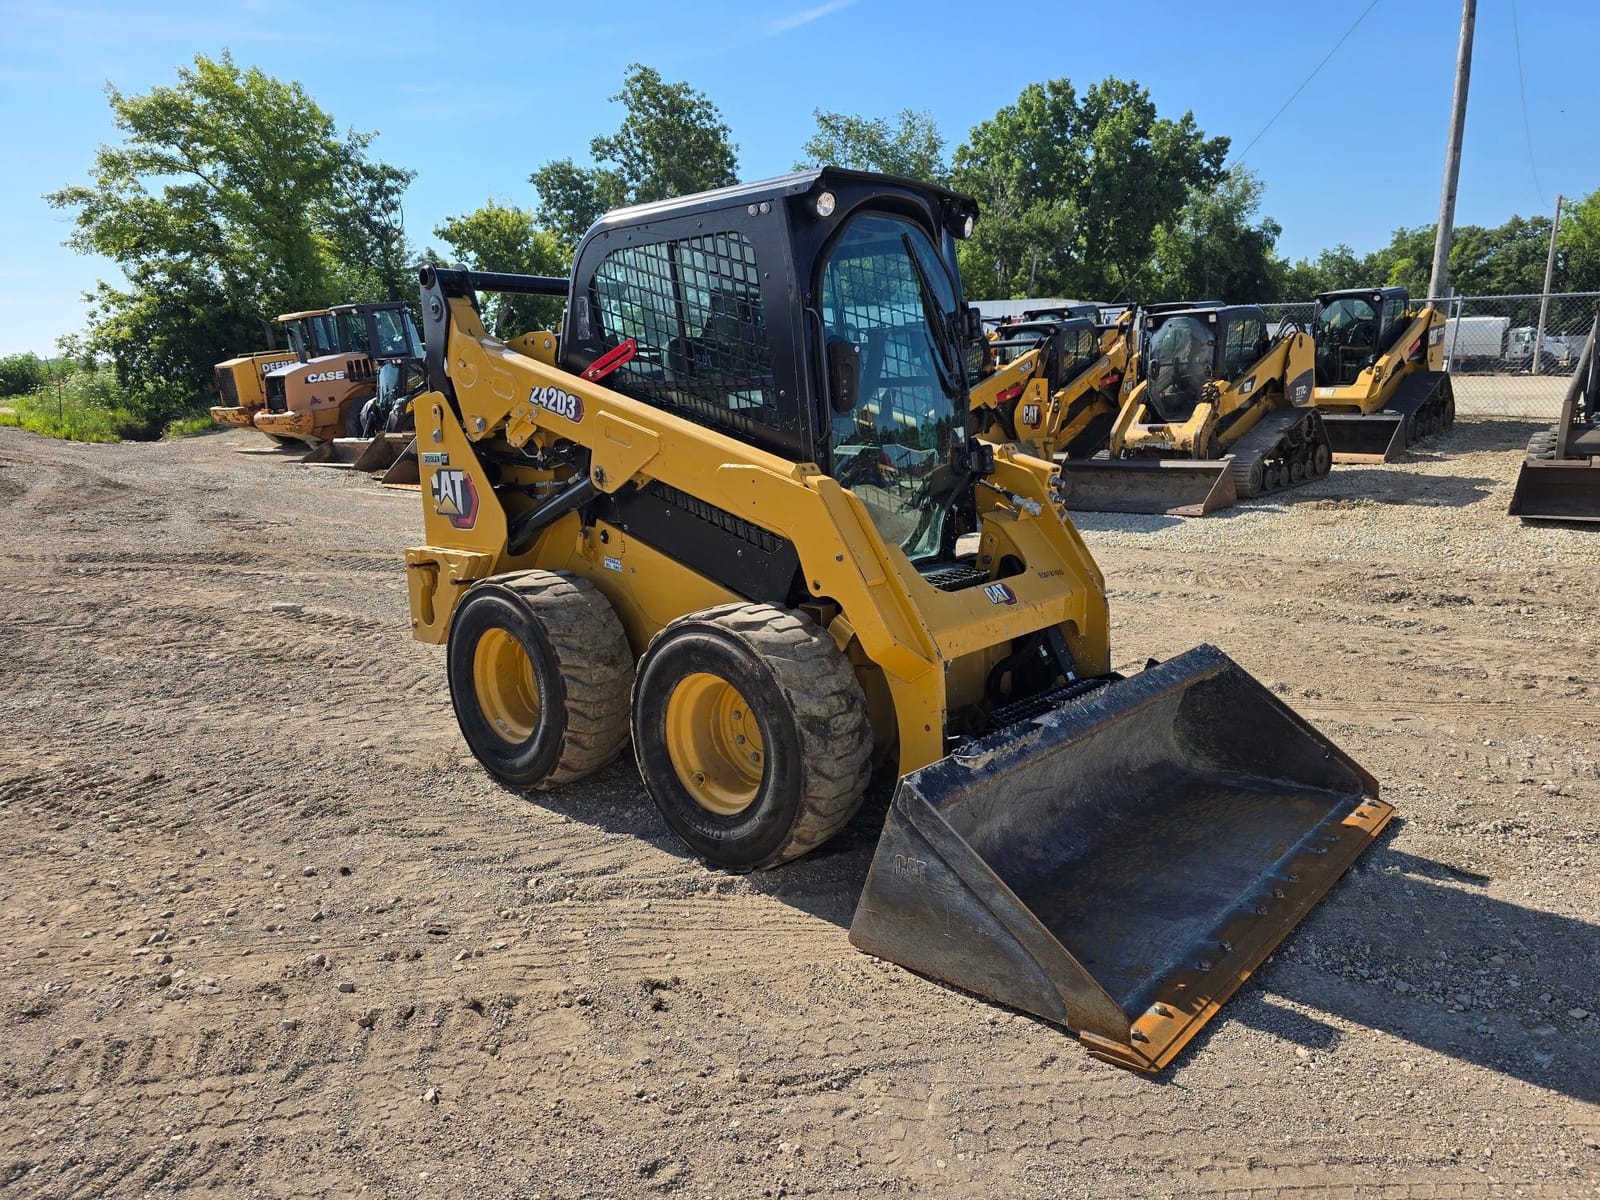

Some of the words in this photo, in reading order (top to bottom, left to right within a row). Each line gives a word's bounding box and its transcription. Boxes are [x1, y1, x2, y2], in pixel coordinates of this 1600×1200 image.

[261, 360, 294, 373] DEER
[307, 370, 344, 383] CASE
[1023, 405, 1039, 424] CAT
[984, 583, 1010, 604] CAT
